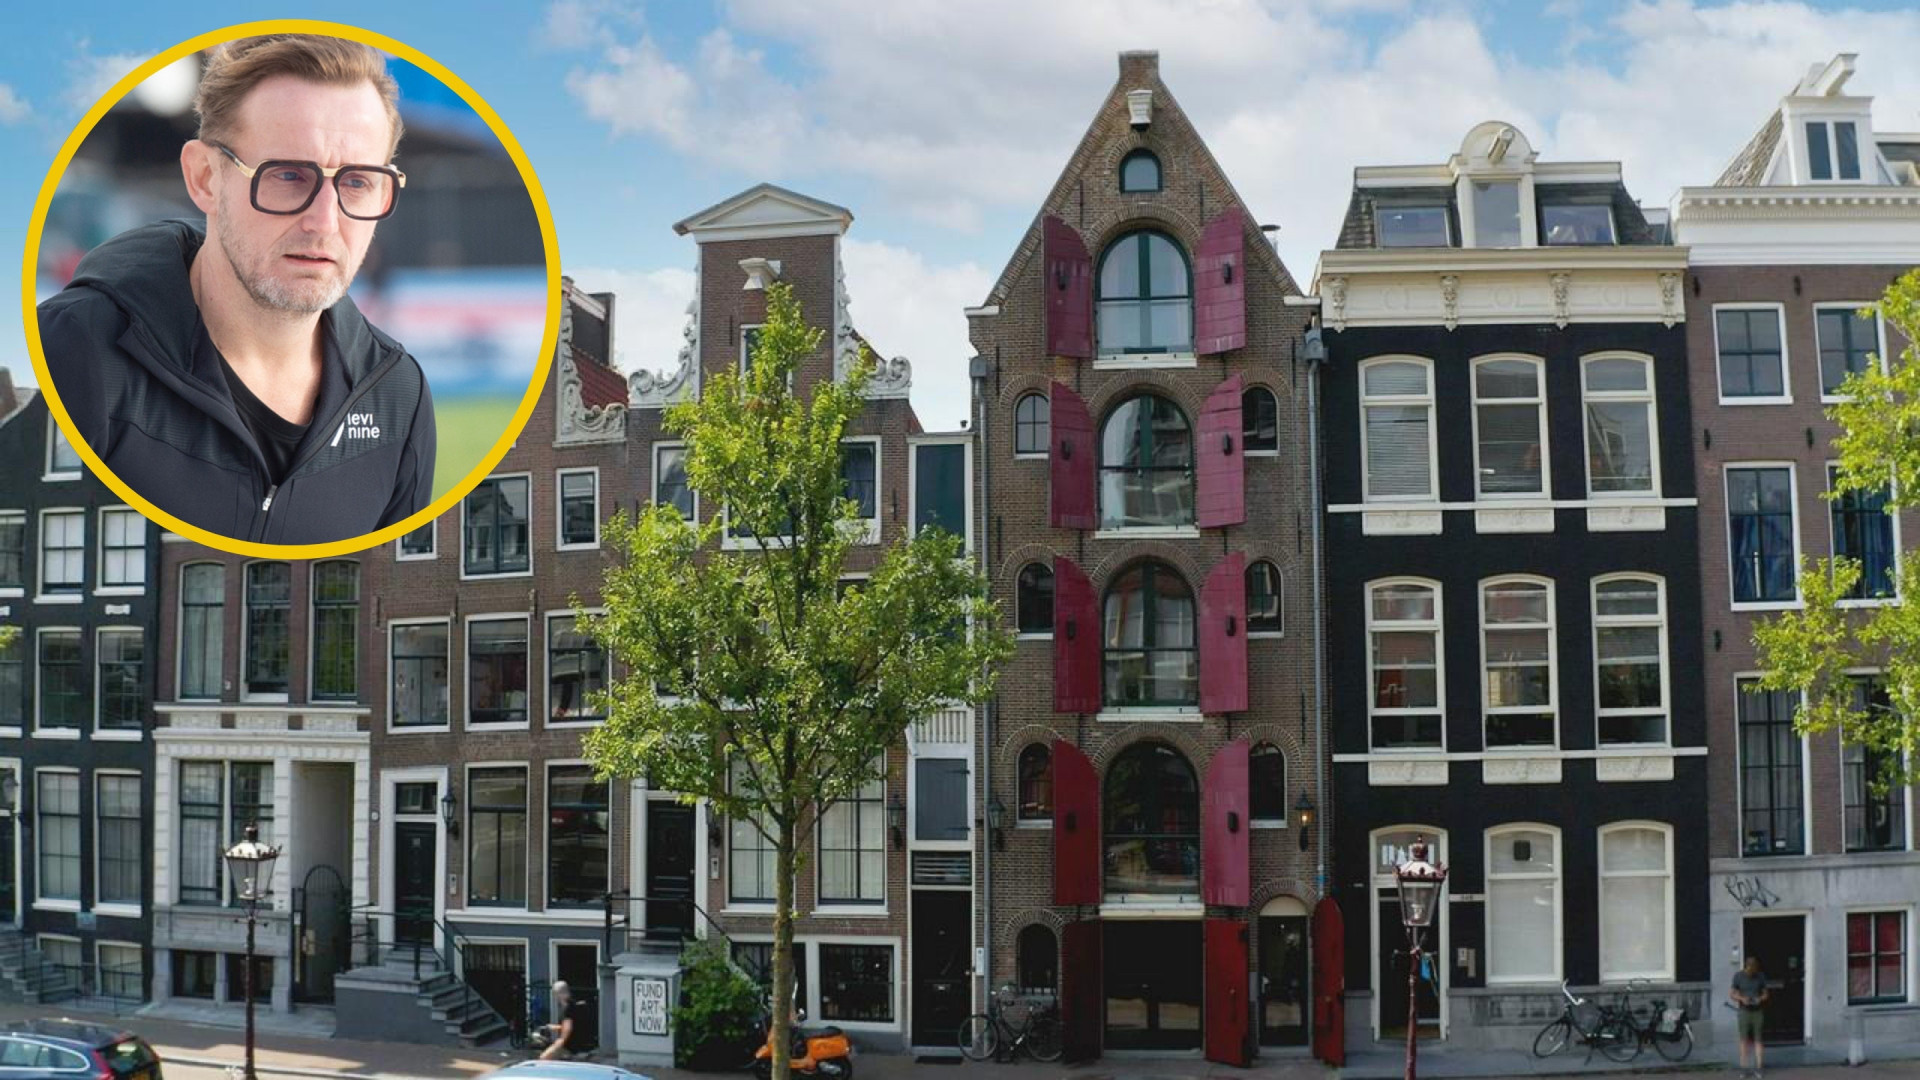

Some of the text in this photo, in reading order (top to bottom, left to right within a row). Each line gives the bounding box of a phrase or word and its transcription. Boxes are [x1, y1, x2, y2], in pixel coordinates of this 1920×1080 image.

[347, 412, 373, 425] levi
[348, 426, 380, 439] nine
[636, 983, 663, 998] FUND
[640, 1000, 659, 1014] ART
[638, 1016, 663, 1031] NOW
